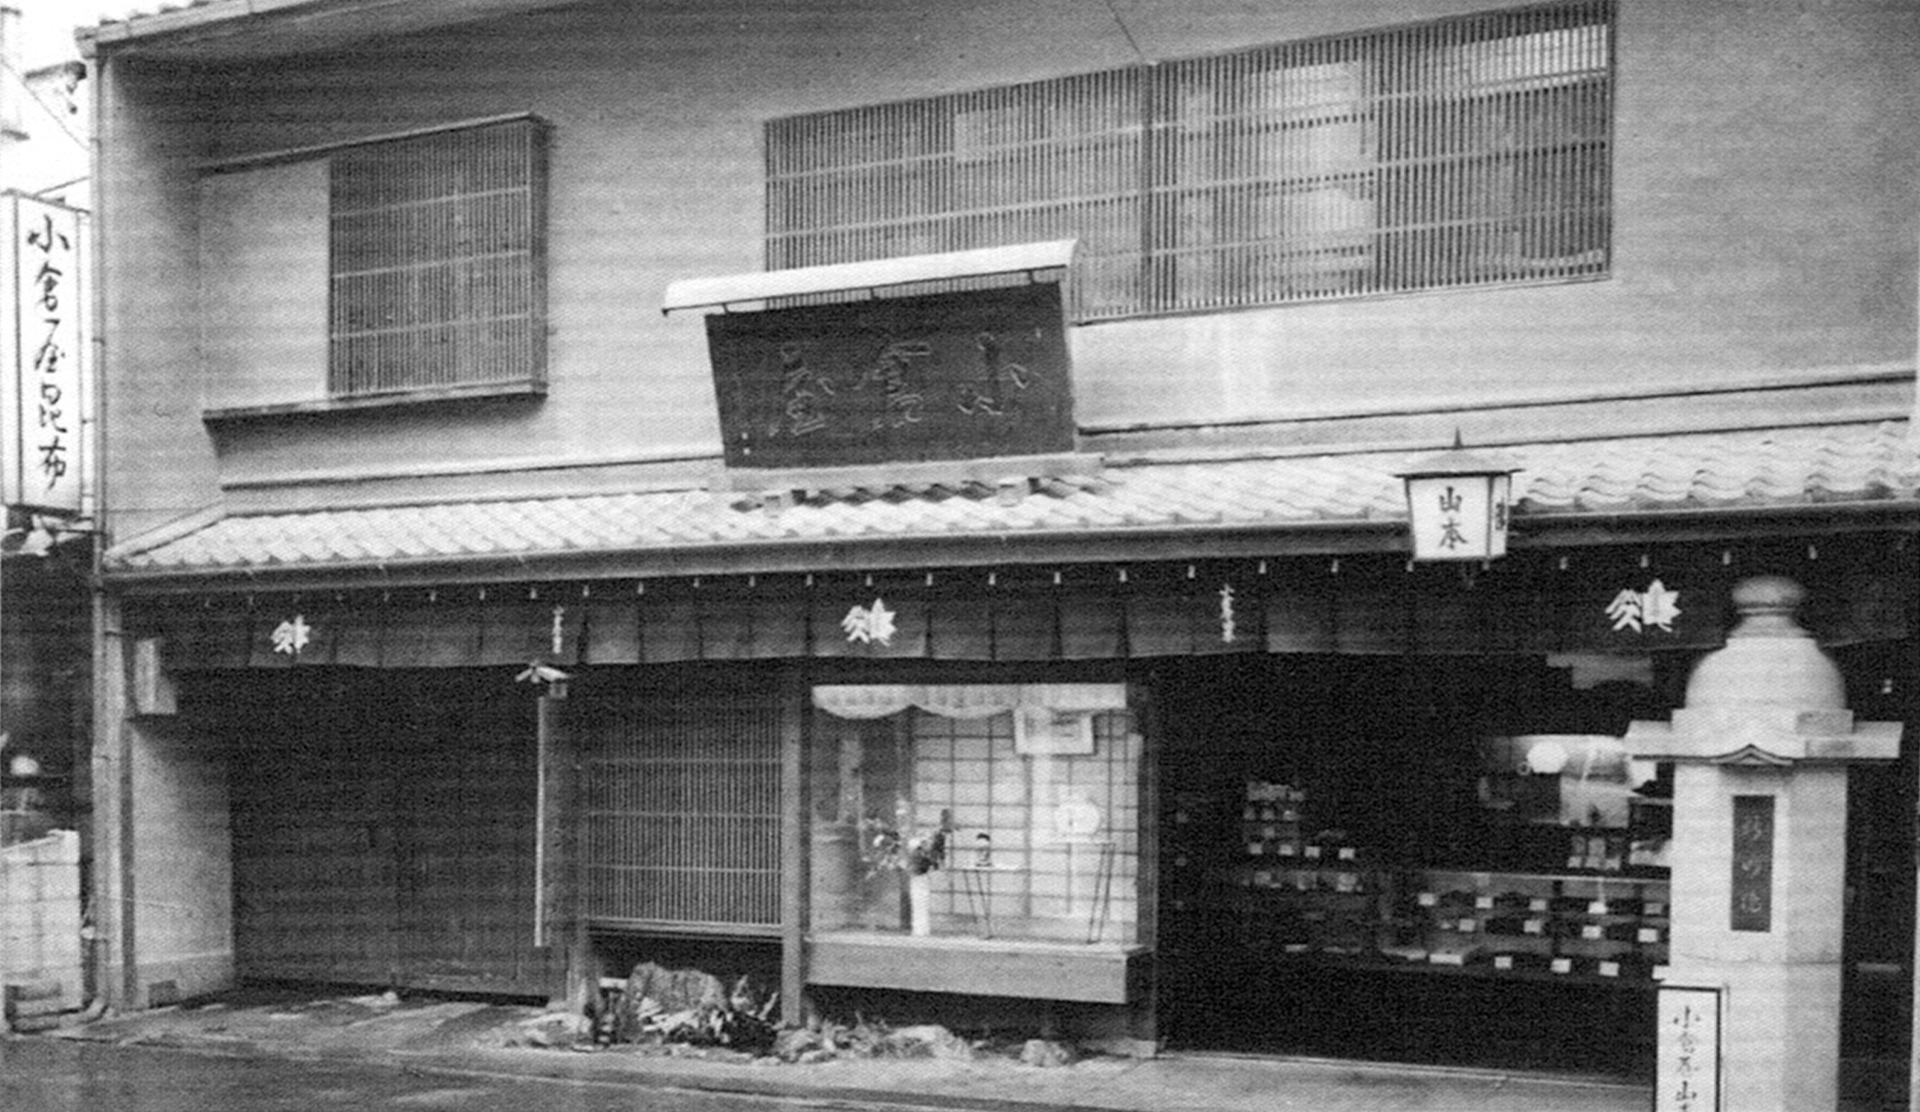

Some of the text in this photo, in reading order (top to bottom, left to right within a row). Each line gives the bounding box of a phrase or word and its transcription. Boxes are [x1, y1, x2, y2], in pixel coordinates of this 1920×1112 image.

[27, 213, 71, 491] 小倉屋昆布
[1438, 486, 1468, 550] 山本
